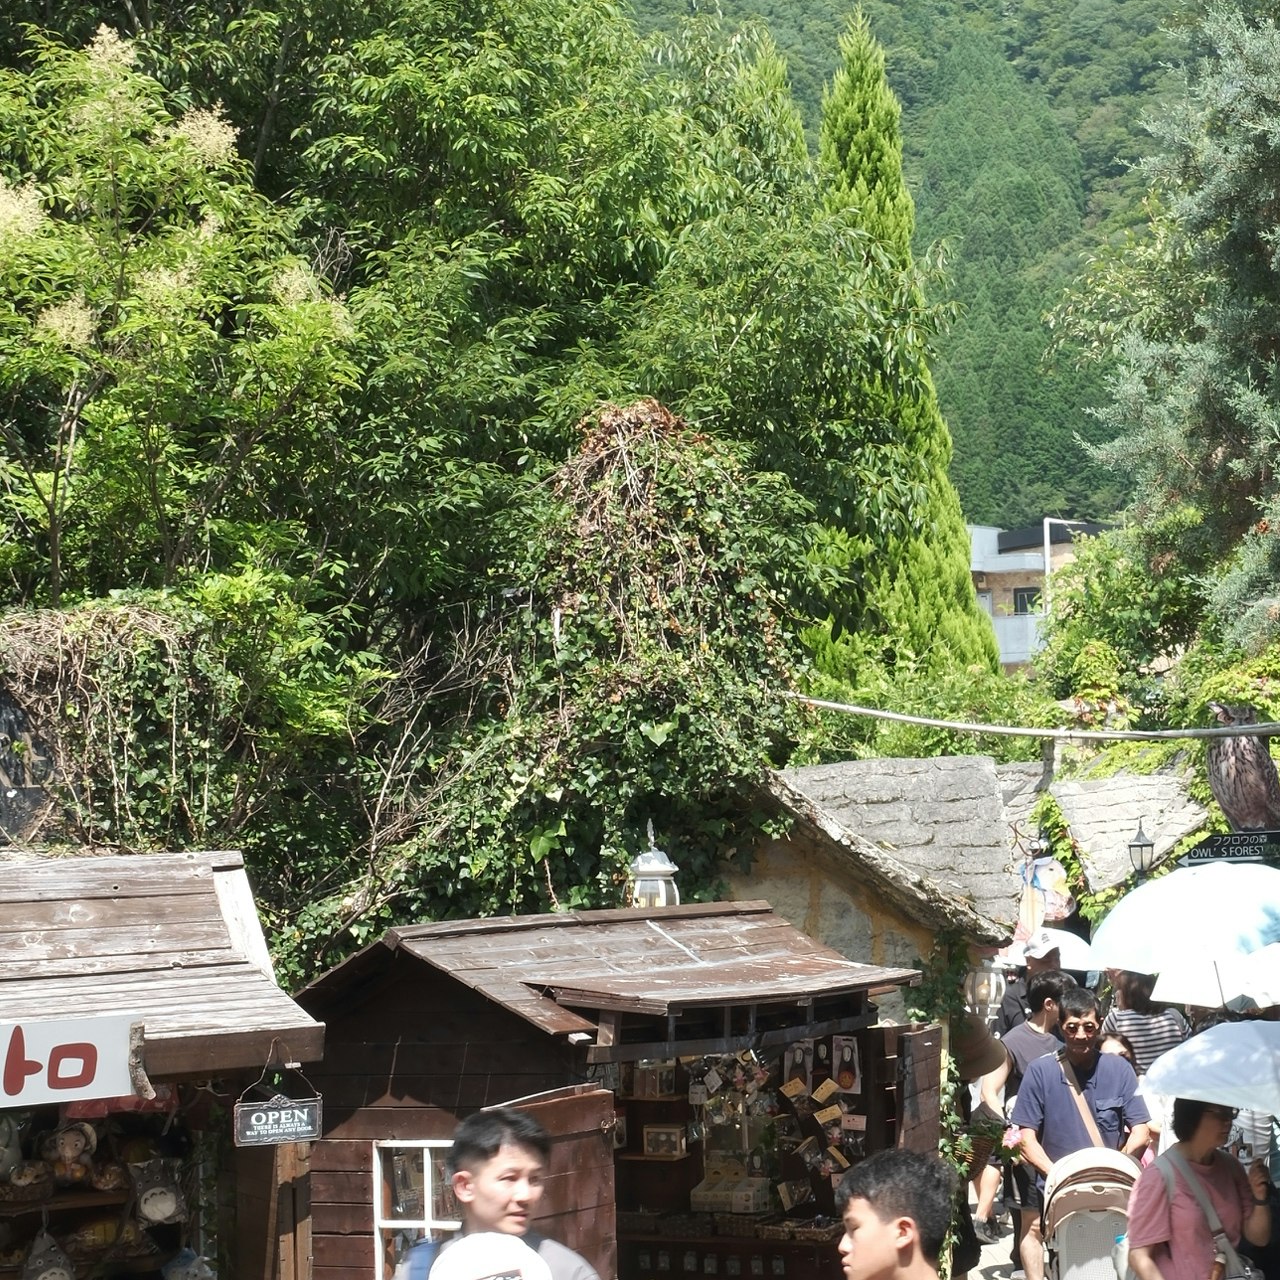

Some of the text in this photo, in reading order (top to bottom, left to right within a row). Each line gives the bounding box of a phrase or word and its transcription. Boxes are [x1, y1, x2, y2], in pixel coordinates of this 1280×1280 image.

[1213, 835, 1268, 846] フクロウの森
[251, 1108, 309, 1125] OPEN
